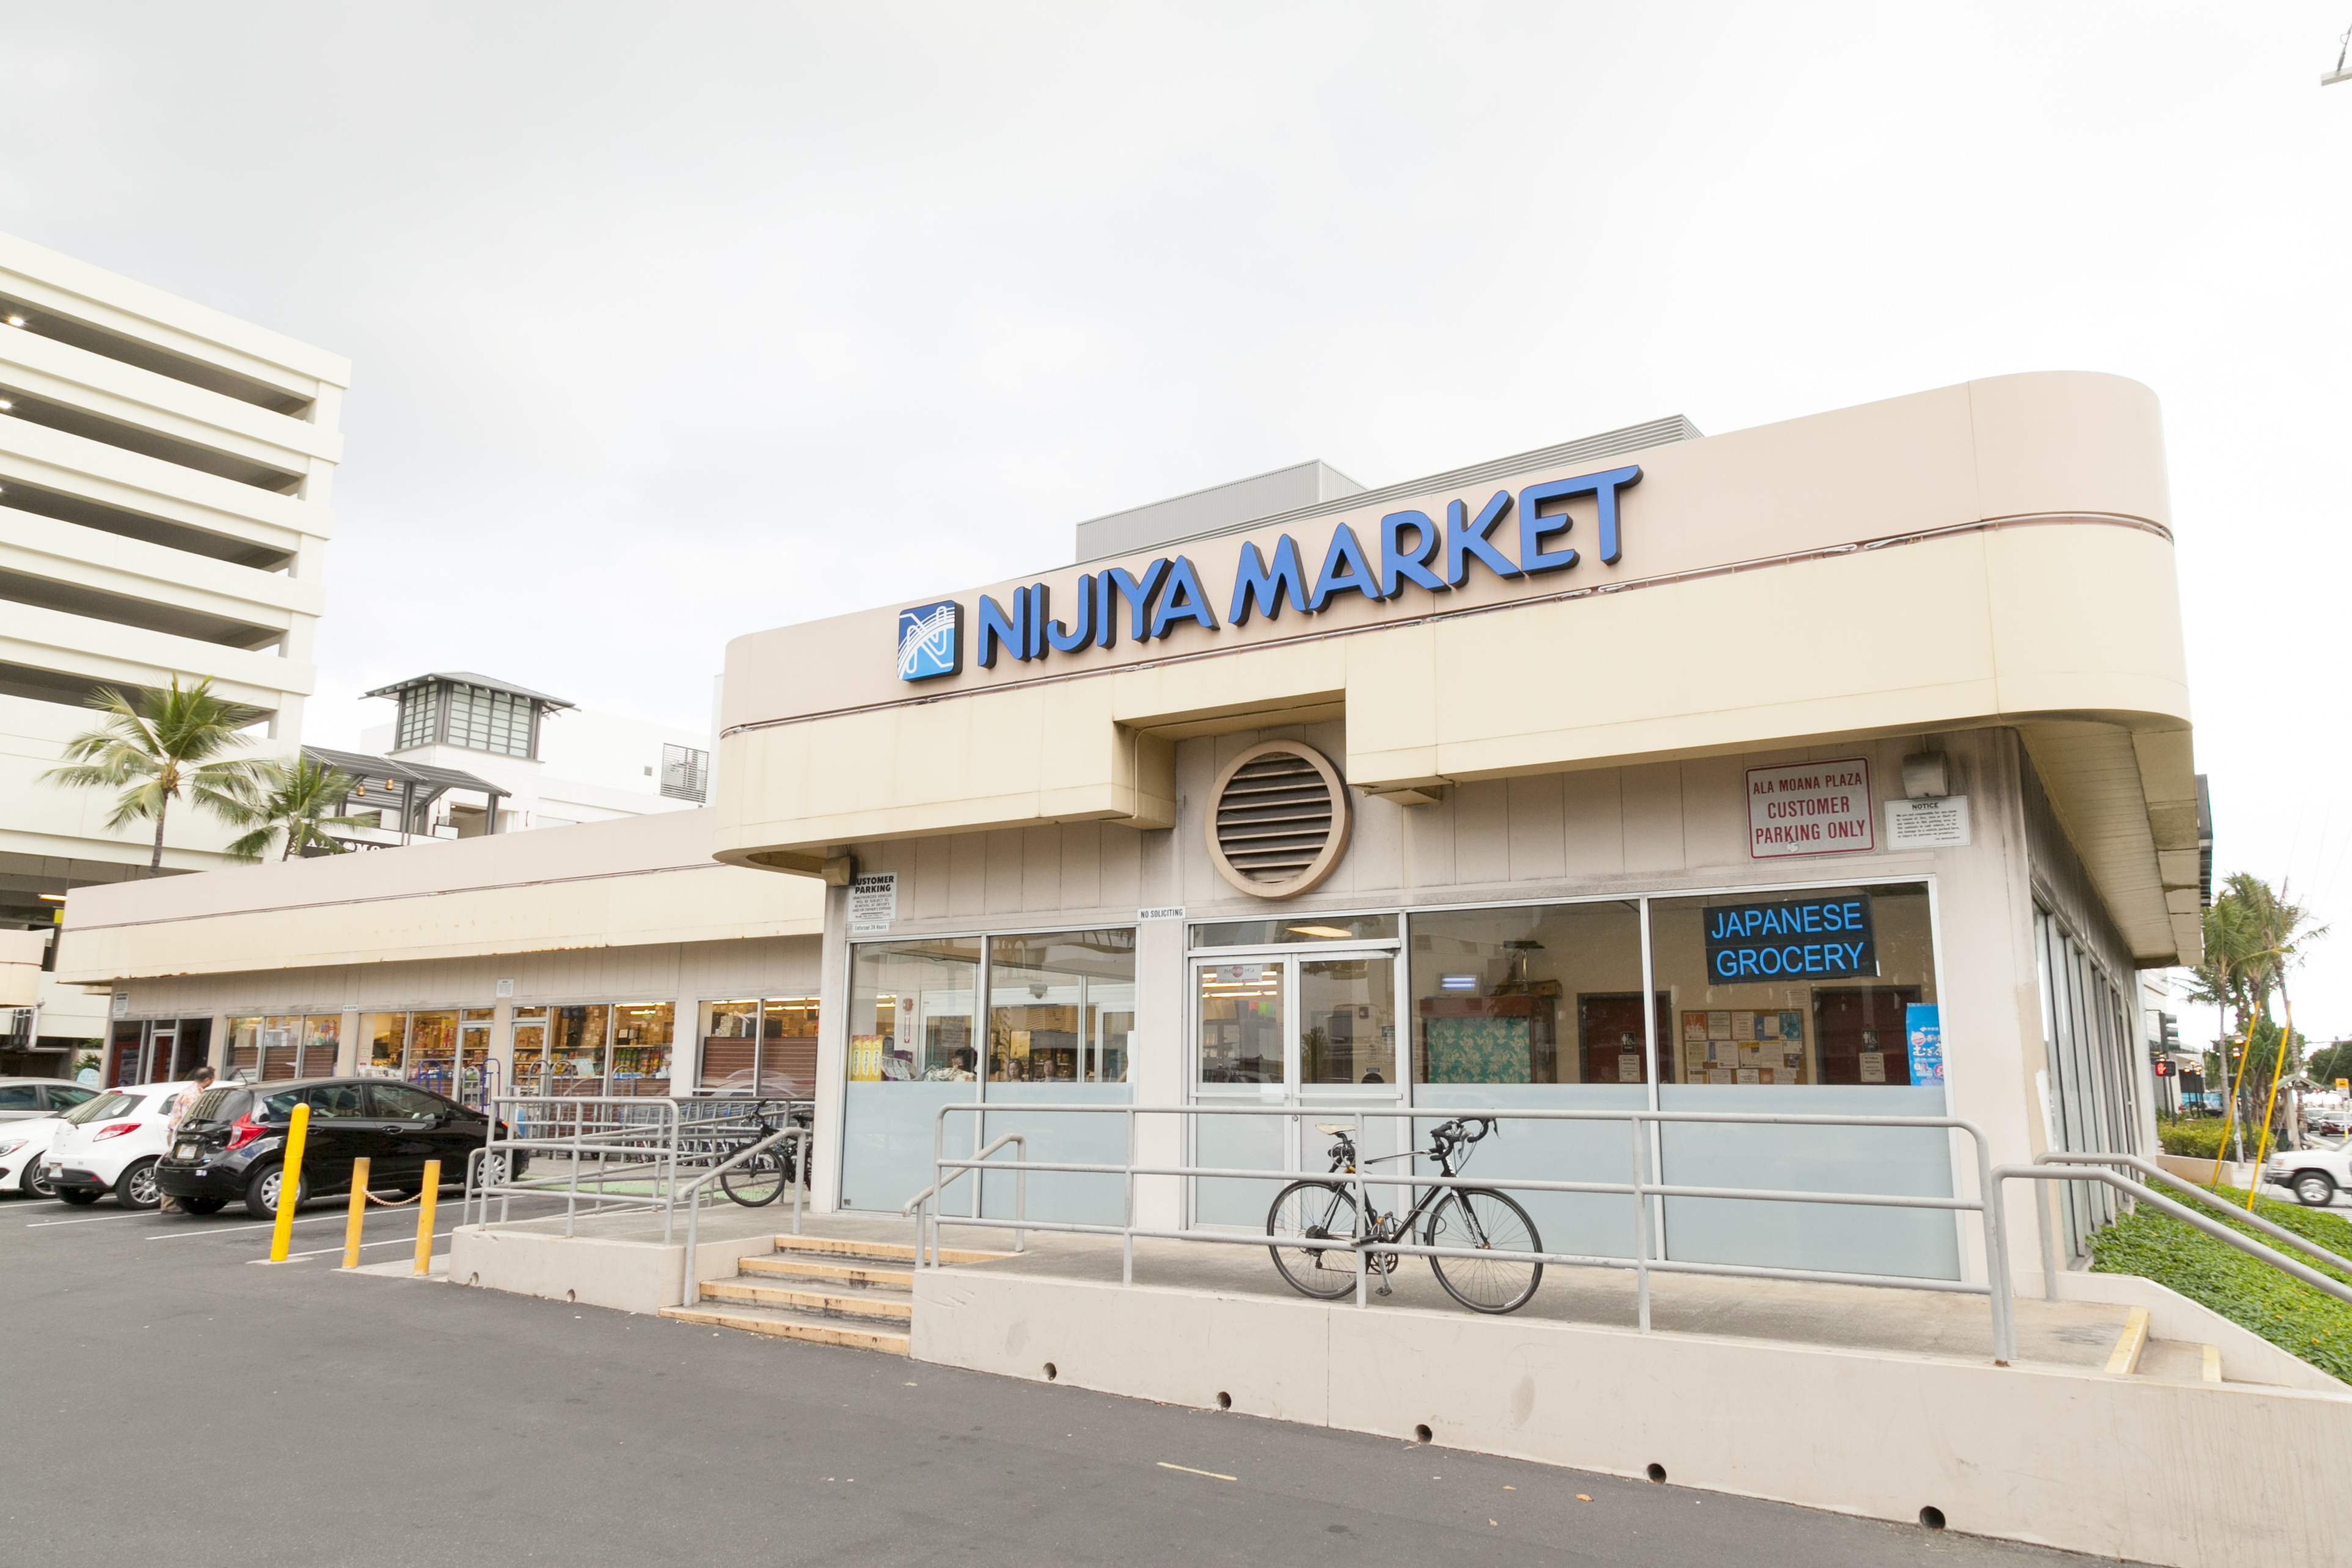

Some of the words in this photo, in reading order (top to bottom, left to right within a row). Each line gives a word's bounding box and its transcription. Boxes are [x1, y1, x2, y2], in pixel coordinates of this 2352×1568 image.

[977, 555, 1219, 668] NIJIYA
[1228, 465, 1643, 625] MARKET
[1753, 781, 1774, 795] ALA
[1779, 776, 1821, 792] MOANA
[1825, 773, 1862, 787] PLAZA
[1767, 796, 1850, 819] CUSTOMER
[1756, 823, 1821, 845] PARKING
[1827, 820, 1865, 839] ONLY
[855, 884, 891, 894] PARKING
[856, 875, 894, 885] USTOMER
[1151, 908, 1183, 918] SOLICITING
[1711, 902, 1863, 939] JAPANESE
[1716, 942, 1864, 977] GROCERY
